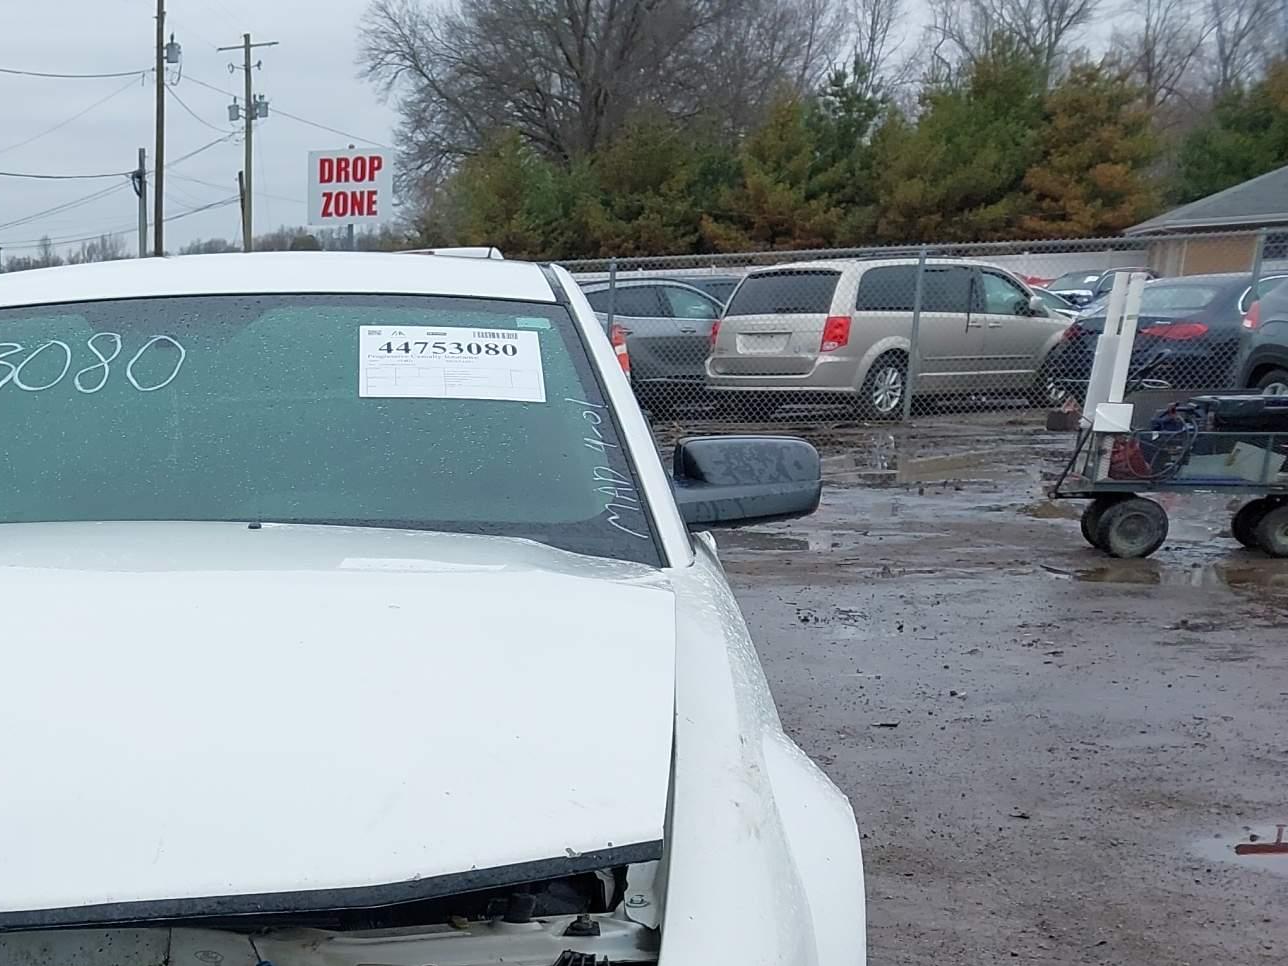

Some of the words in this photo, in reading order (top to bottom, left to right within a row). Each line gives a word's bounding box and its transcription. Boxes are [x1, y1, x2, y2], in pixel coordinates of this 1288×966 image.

[319, 156, 383, 184] DROP
[321, 190, 378, 217] ZONE
[378, 341, 518, 357] 44753080
